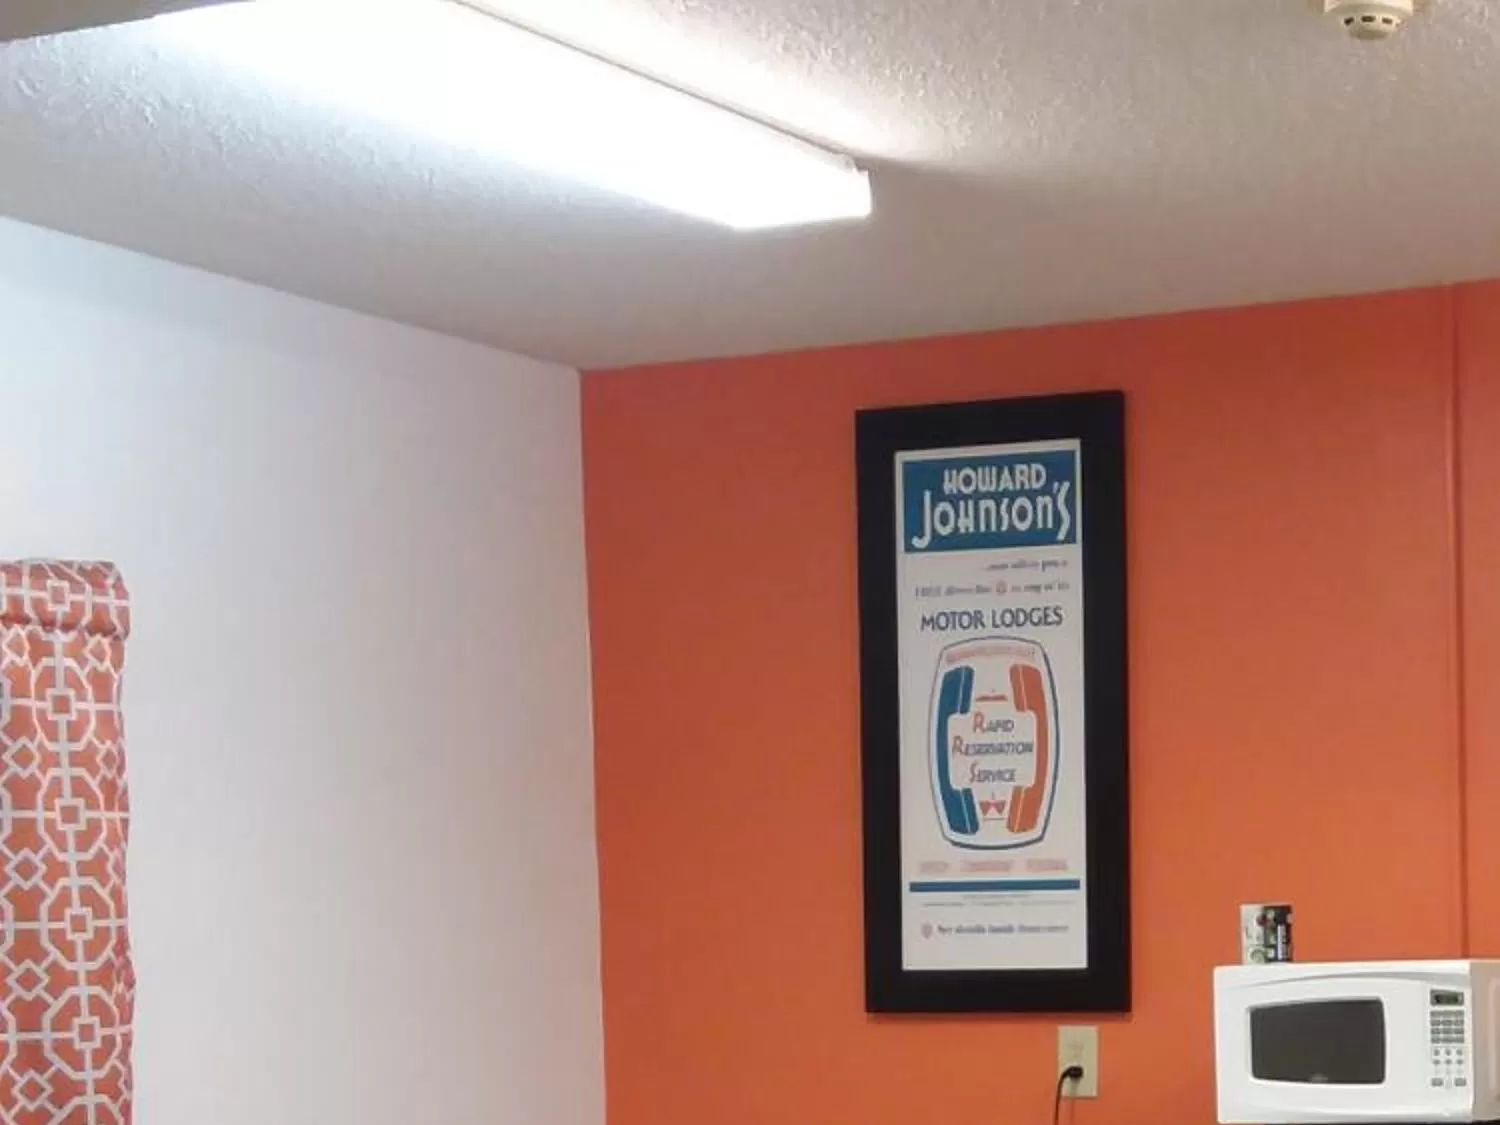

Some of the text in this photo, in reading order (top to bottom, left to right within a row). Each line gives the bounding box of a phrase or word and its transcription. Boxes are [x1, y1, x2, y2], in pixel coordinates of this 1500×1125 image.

[943, 464, 1047, 495] HOWARD
[920, 605, 1063, 632] MOTOR LODGES
